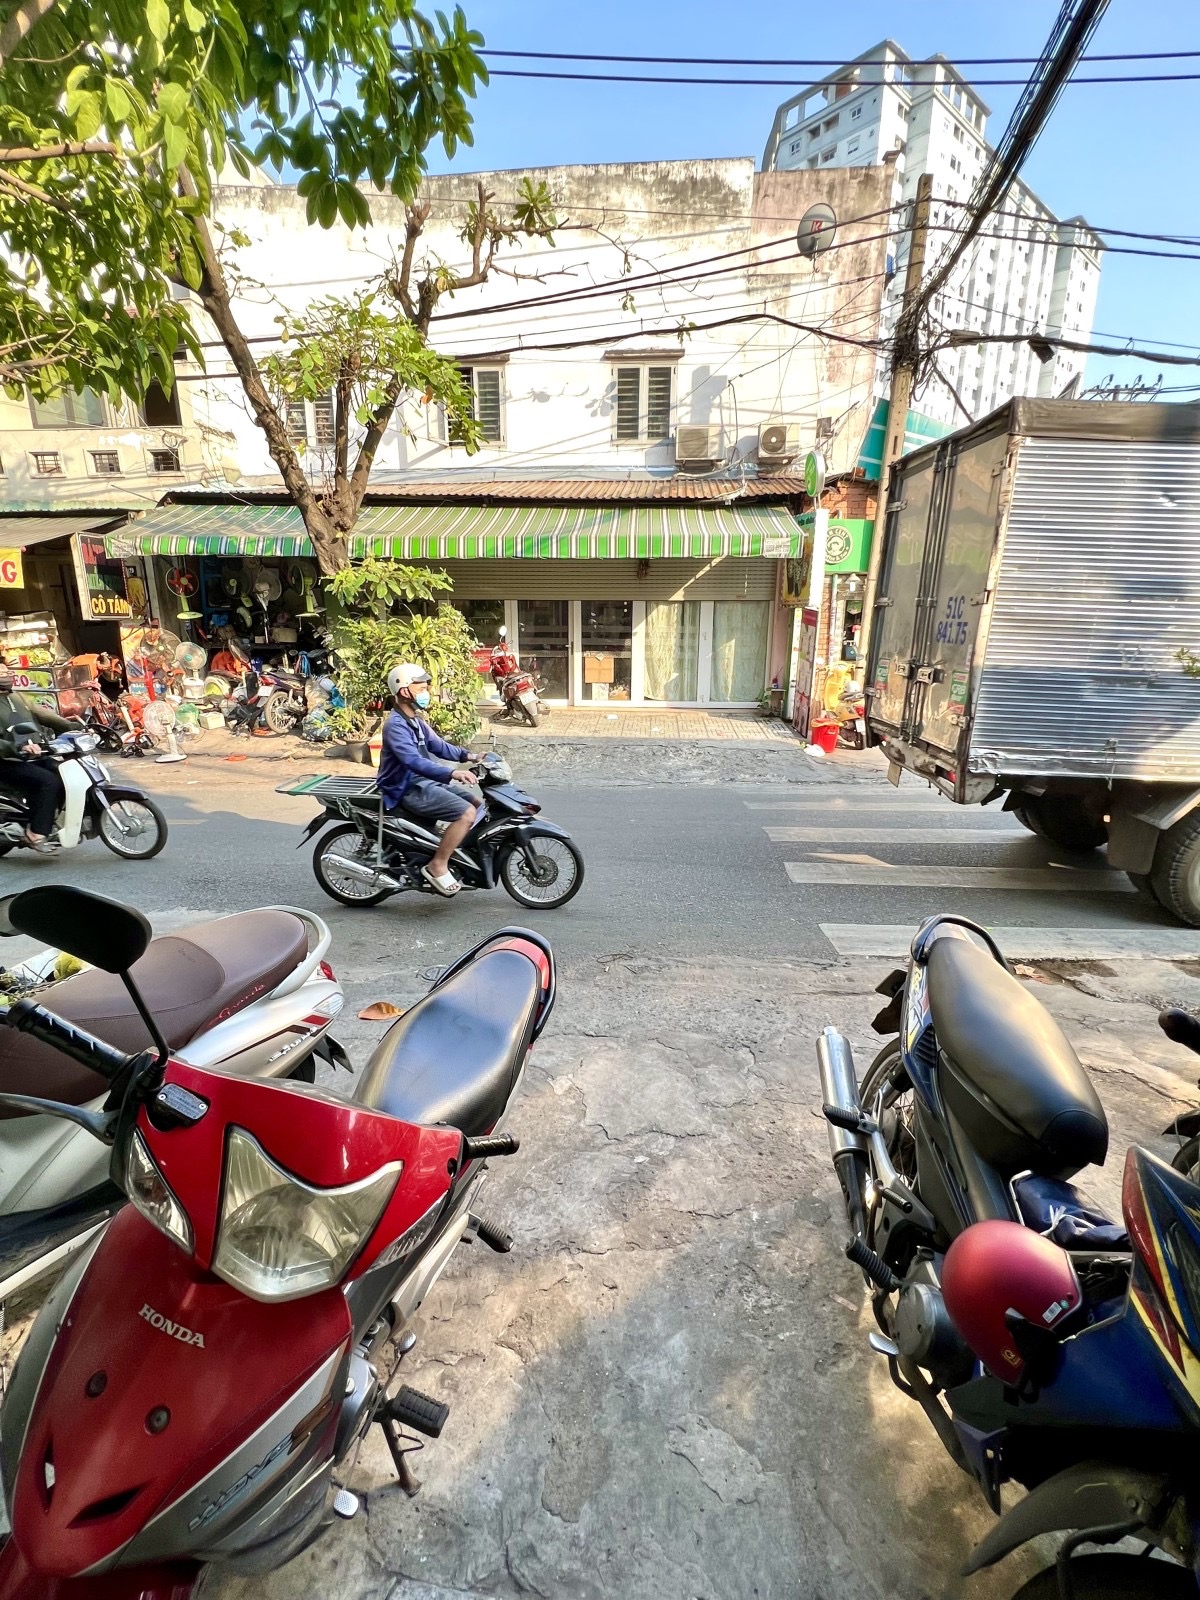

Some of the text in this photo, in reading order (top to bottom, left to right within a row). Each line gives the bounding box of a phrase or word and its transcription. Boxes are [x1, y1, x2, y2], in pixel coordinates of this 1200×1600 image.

[0, 561, 18, 584] G
[91, 594, 130, 614] CÔ TÁM
[946, 595, 965, 620] 51C
[936, 621, 969, 645] 841.75
[138, 1303, 206, 1349] HONDA
